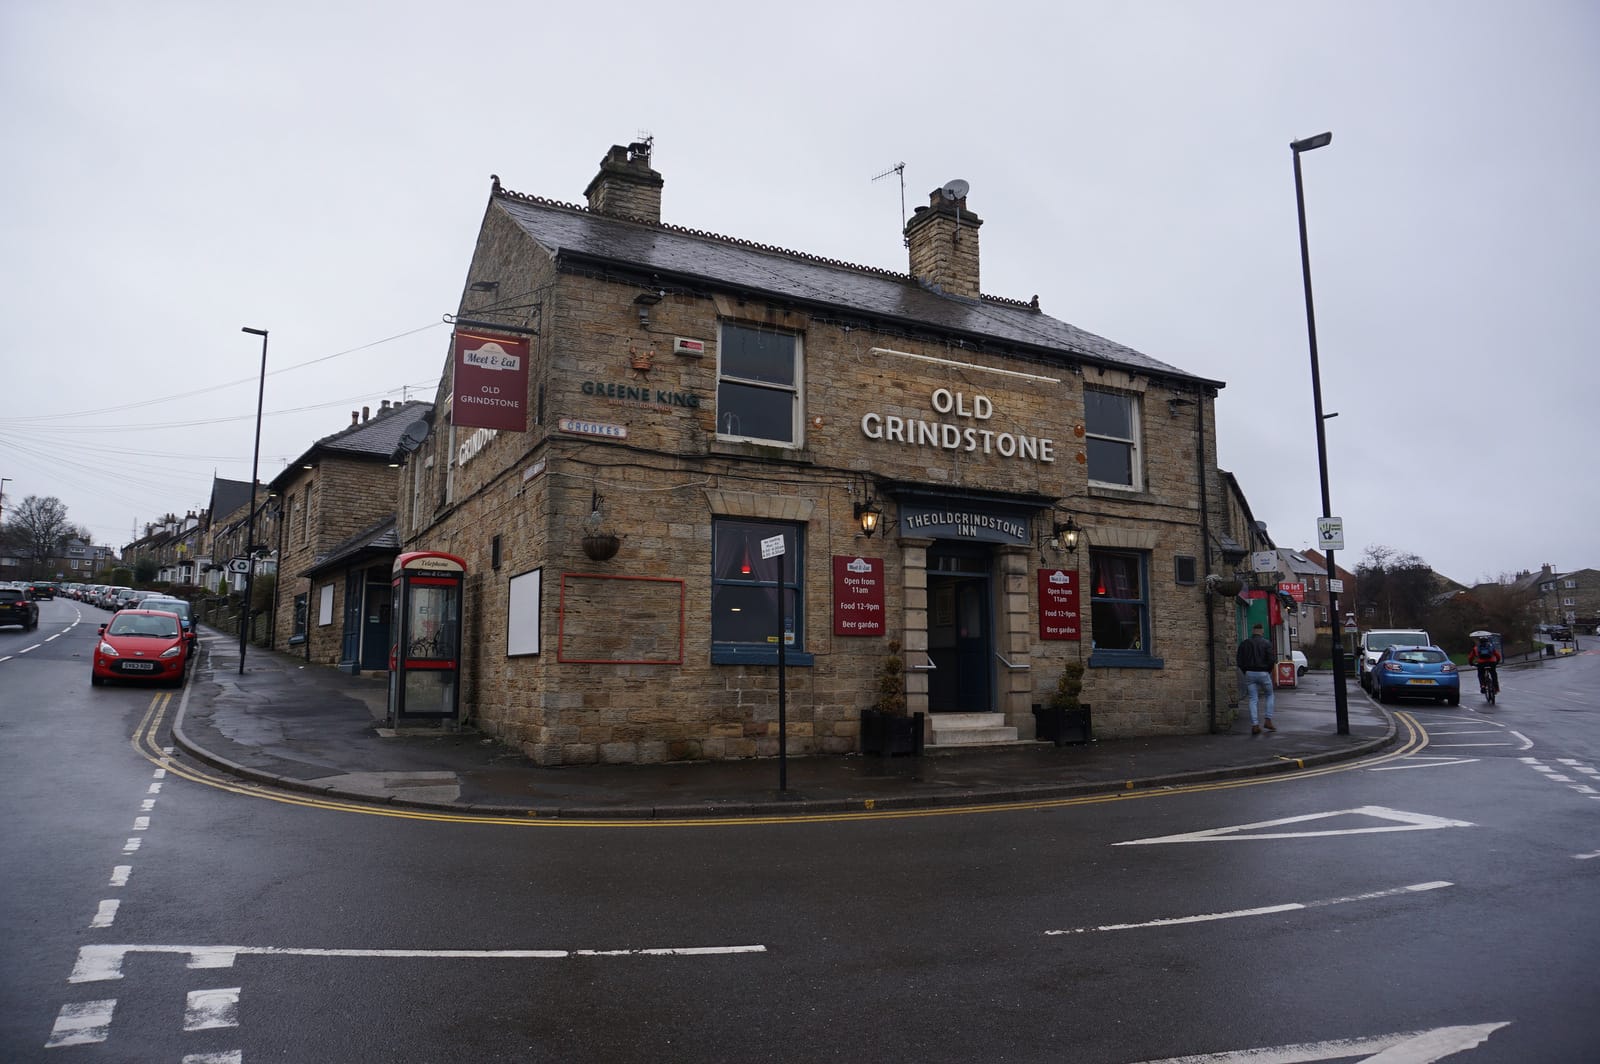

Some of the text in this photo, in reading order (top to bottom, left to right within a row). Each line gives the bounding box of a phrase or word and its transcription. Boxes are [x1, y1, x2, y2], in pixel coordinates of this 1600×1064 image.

[467, 352, 516, 368] Meet & Eat
[481, 385, 500, 394] OLD
[581, 381, 700, 408] GREENE KING
[460, 395, 520, 409] GRINDSTONE
[931, 388, 993, 420] OLD
[567, 421, 620, 436] CROOKES
[861, 412, 1055, 462] GRINDSTONE
[958, 524, 977, 537] INN
[844, 577, 860, 586] Open
[852, 586, 869, 594] 11am
[841, 602, 880, 612] Food 12-9pm
[842, 620, 879, 630] Beer garden
